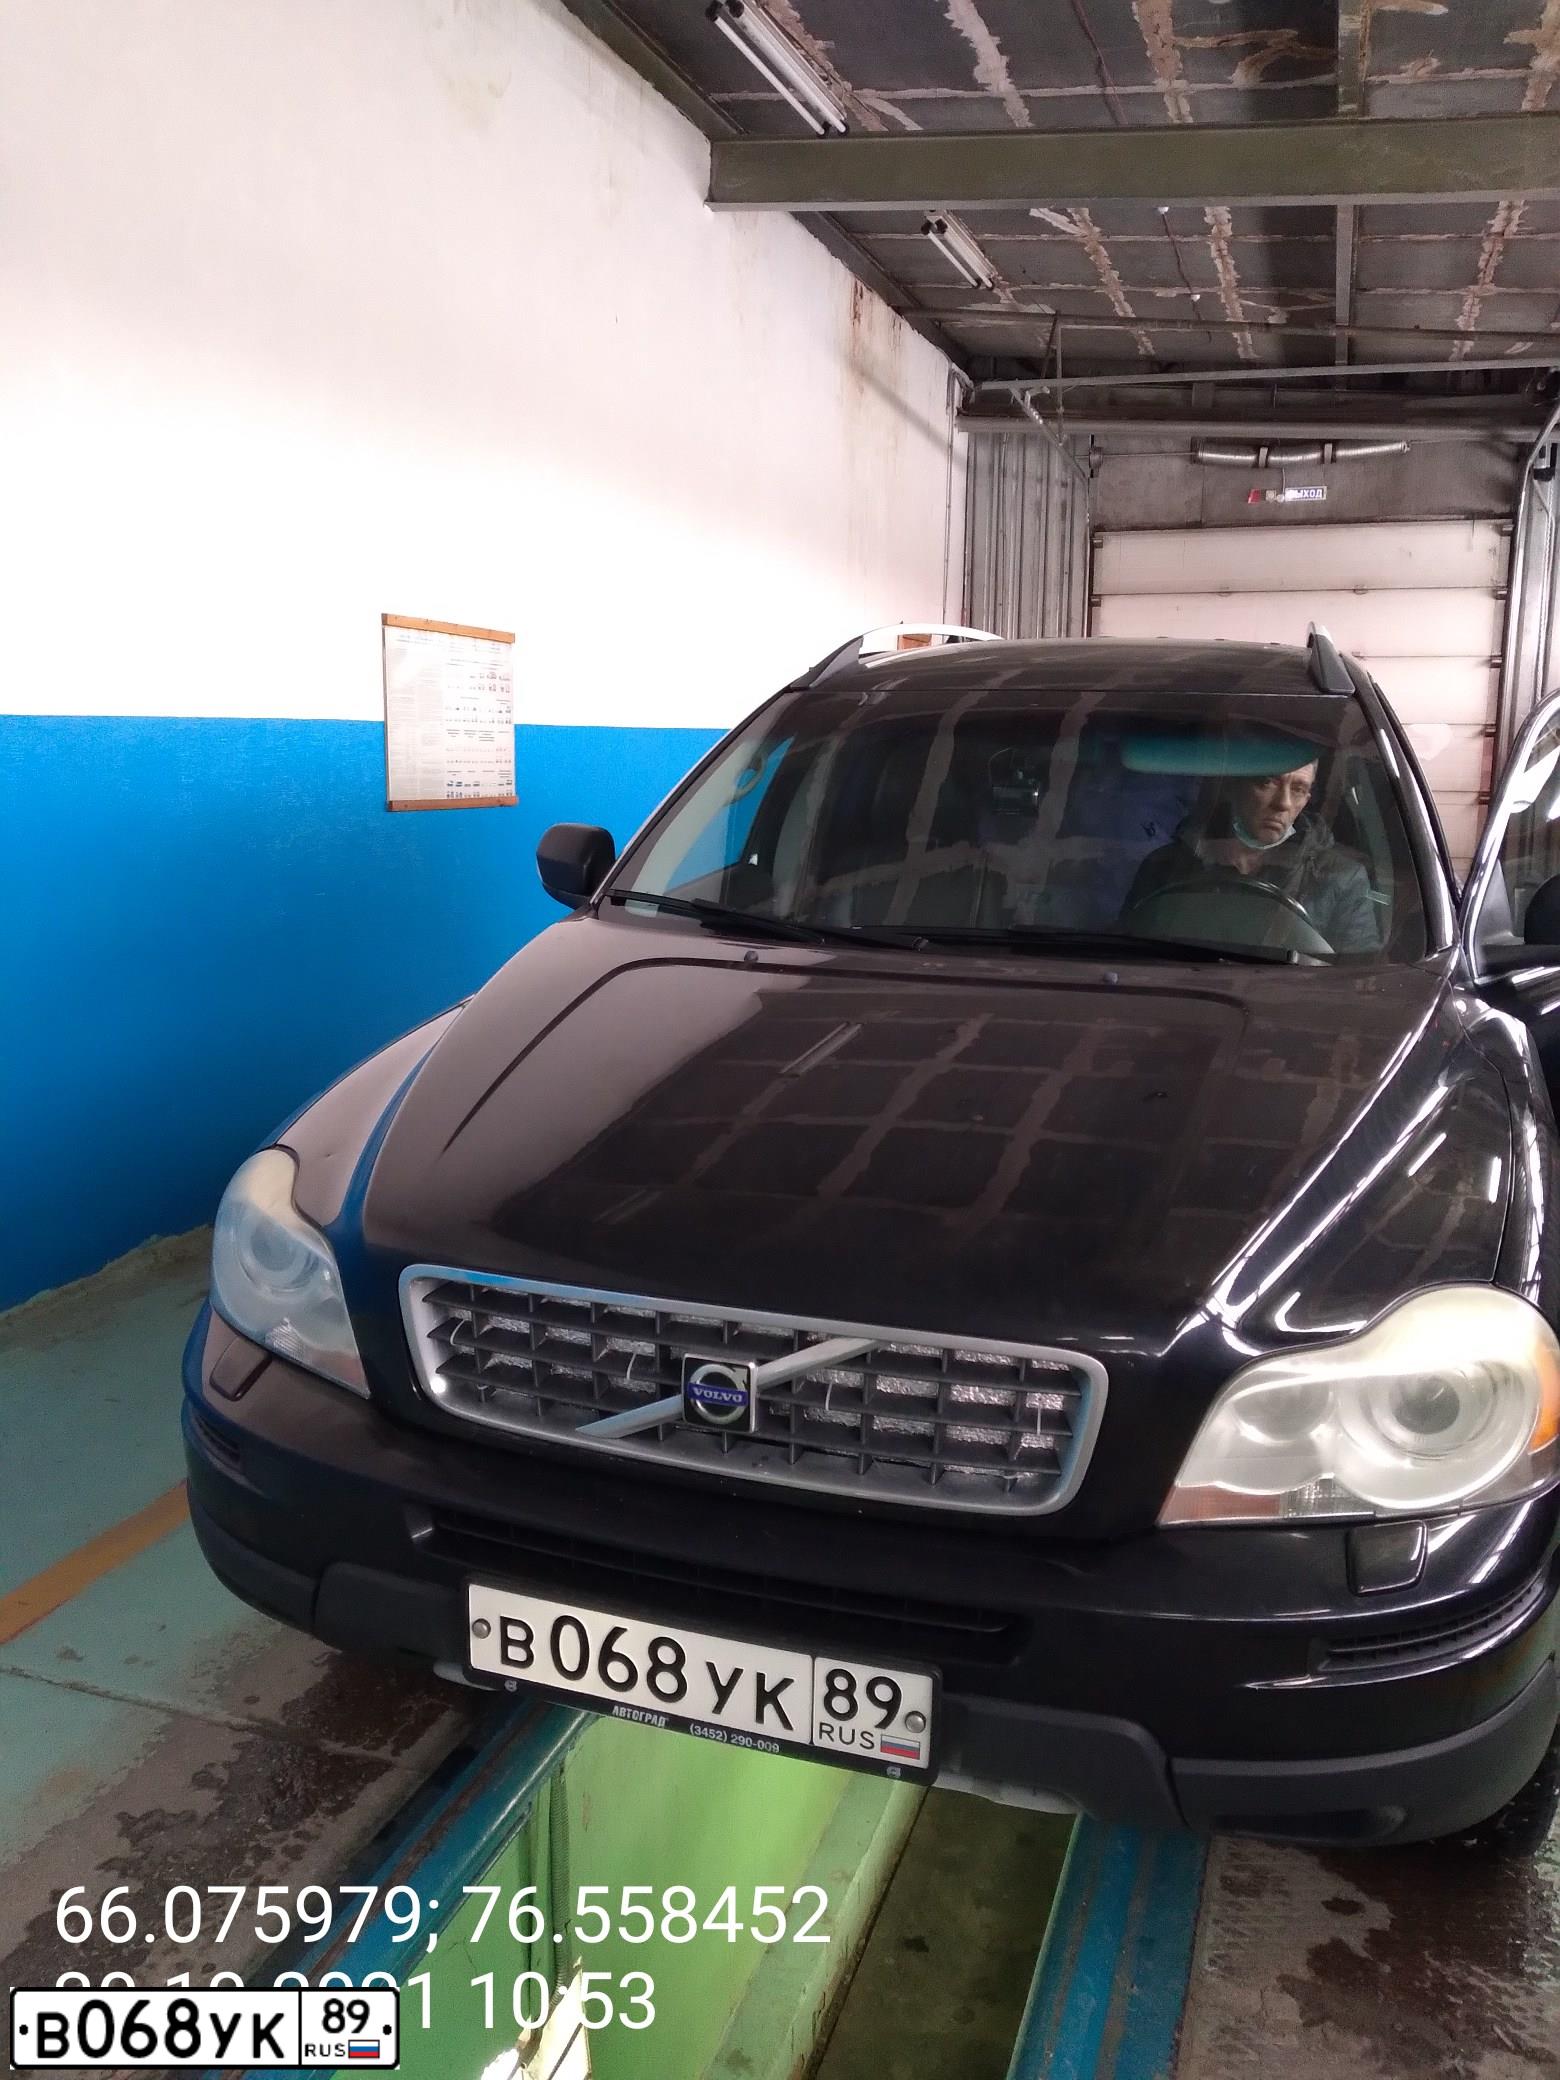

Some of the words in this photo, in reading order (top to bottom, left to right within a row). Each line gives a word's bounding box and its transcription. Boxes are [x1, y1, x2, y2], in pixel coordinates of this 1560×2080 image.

[1287, 489, 1323, 500] ЫХОД
[693, 1387, 742, 1403] VOLVO
[824, 1668, 902, 1729] 89
[612, 1705, 667, 1728] АВТОГРАД
[689, 1723, 728, 1743] (3452)
[730, 1734, 780, 1753] 290-009
[819, 1721, 875, 1750] RUS
